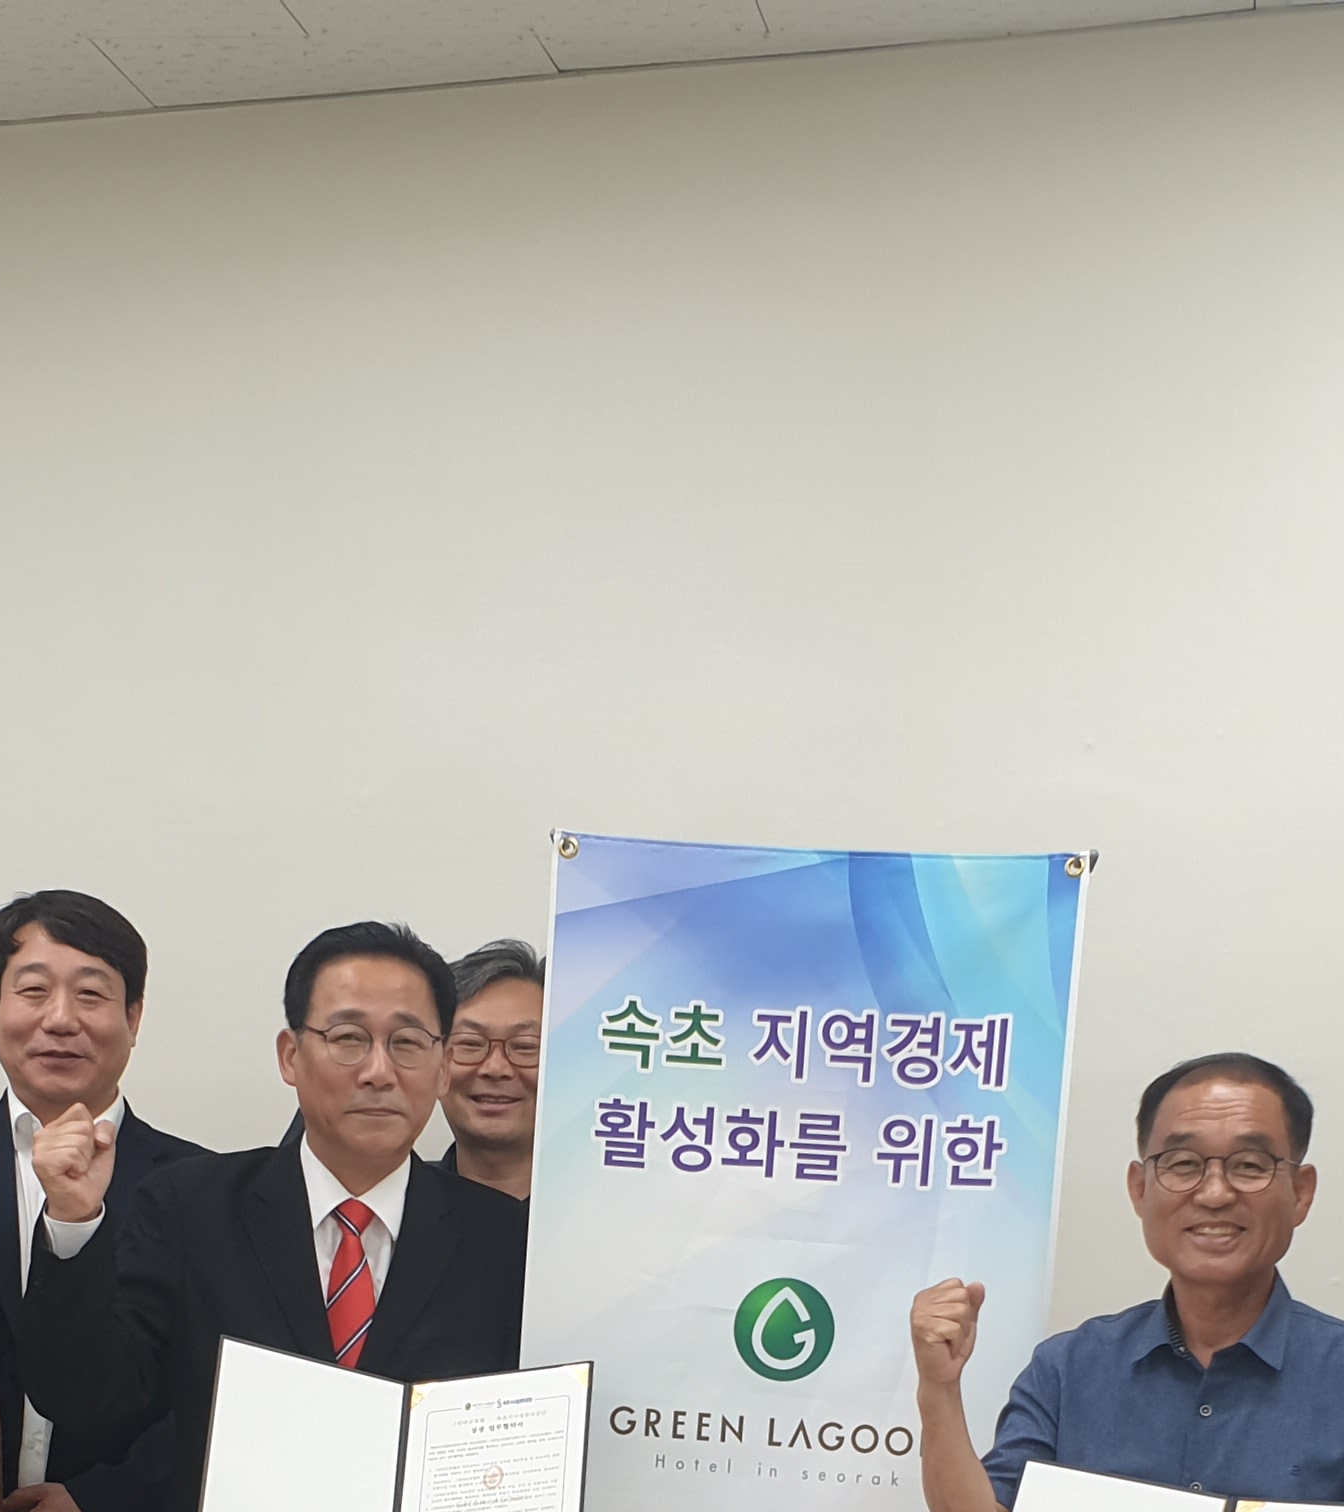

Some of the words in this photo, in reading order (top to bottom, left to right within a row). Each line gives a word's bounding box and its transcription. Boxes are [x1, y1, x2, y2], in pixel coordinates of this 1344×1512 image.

[600, 998, 726, 1070] 속초
[752, 1009, 1012, 1089] 지역경제
[593, 1097, 849, 1182] 활성화를
[875, 1114, 1004, 1188] 위한
[609, 1405, 745, 1444] GREEN
[767, 1417, 923, 1457] LAGOO
[654, 1453, 733, 1474] Hotel
[757, 1461, 778, 1478] in
[801, 1469, 900, 1487] seorak
